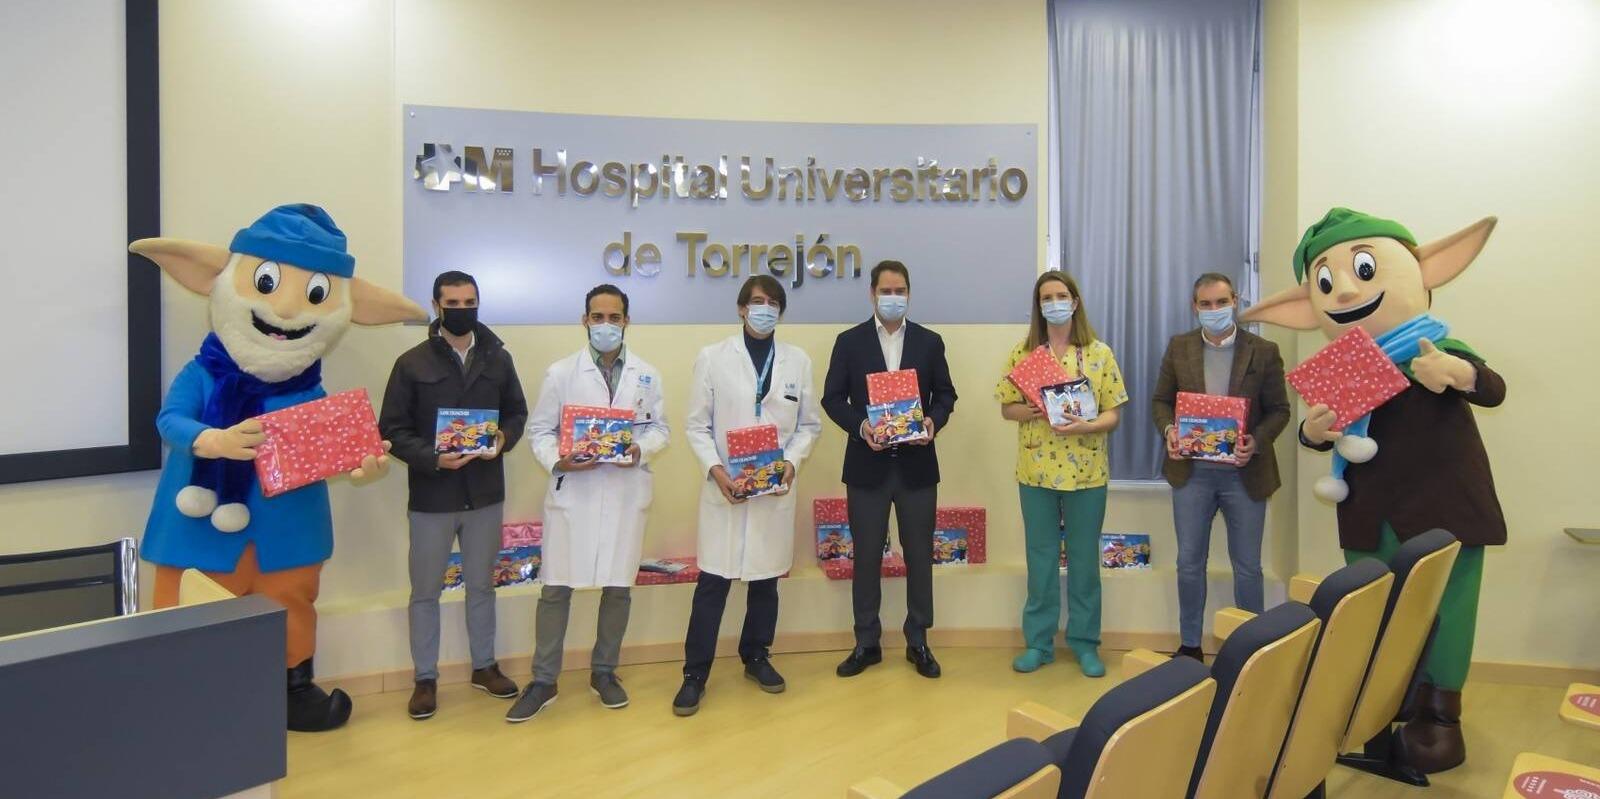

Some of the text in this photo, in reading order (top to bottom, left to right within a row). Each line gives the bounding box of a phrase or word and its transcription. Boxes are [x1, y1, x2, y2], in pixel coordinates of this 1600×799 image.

[532, 148, 728, 208] Hospital
[741, 155, 1028, 202] Universitario
[603, 231, 862, 289] de Torrejón
